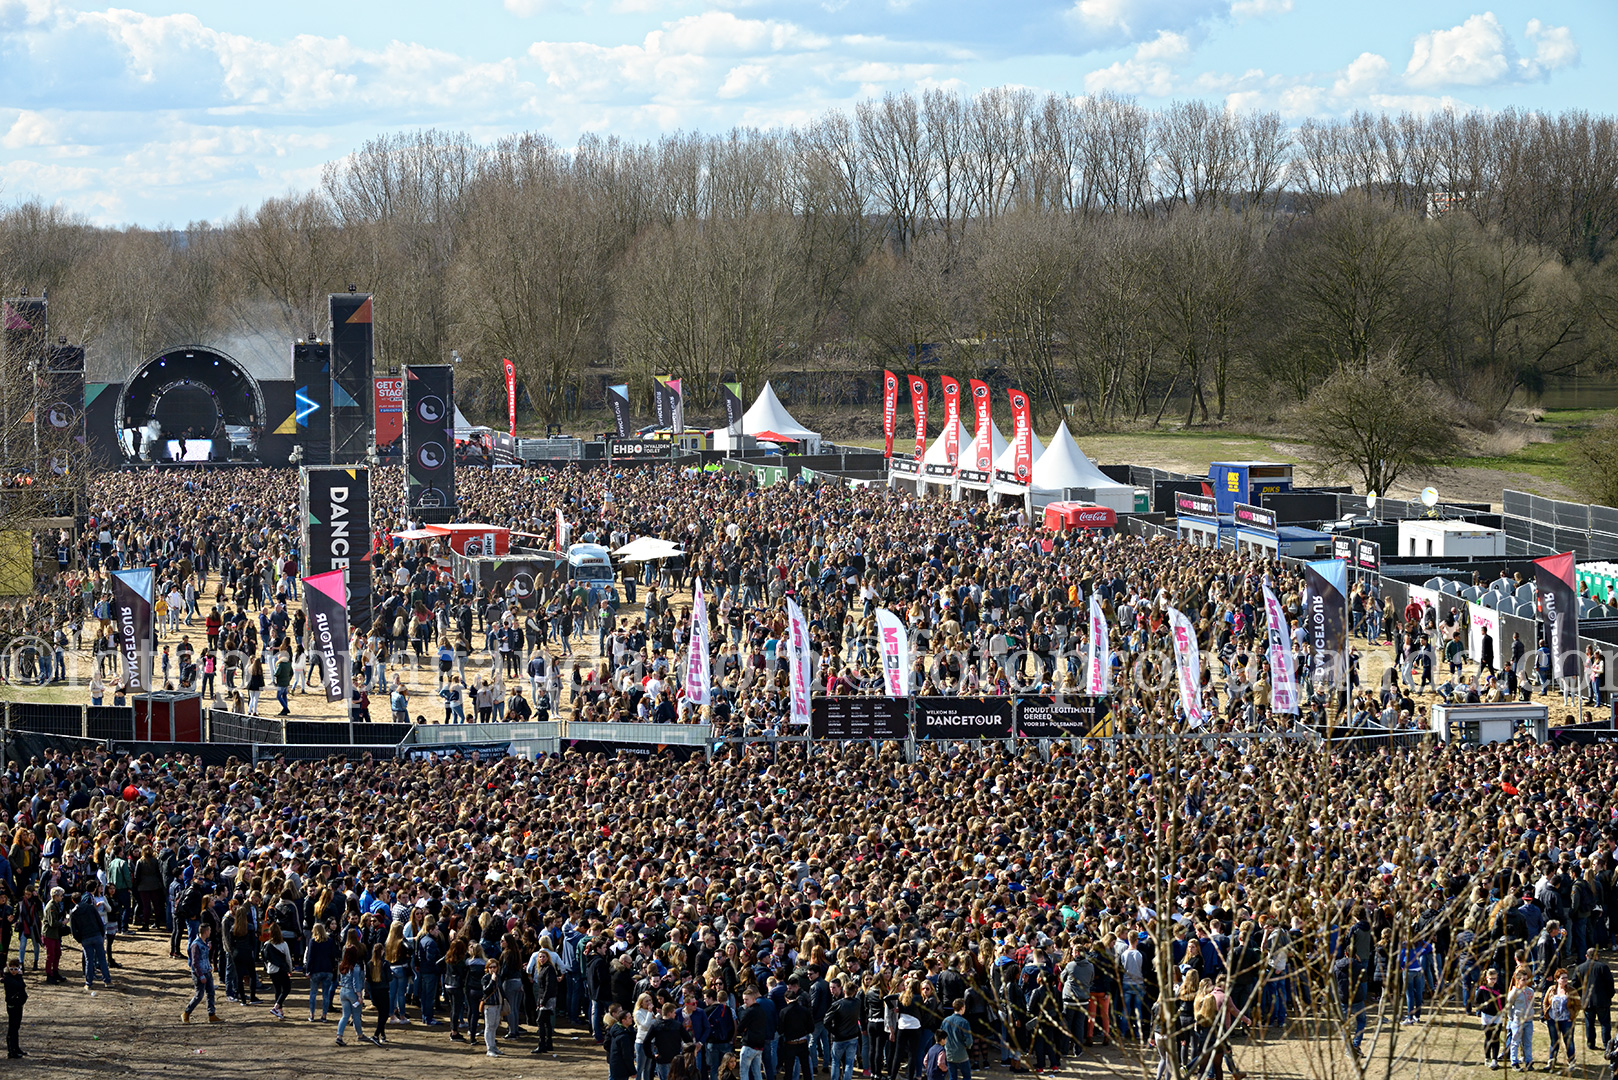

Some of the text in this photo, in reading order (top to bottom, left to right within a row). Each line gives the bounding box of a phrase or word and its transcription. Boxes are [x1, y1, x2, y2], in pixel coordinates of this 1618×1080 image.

[376, 381, 393, 389] GET
[379, 389, 403, 397] STAG
[613, 444, 642, 454] EHBO
[1228, 472, 1239, 482] DIKS
[926, 714, 1002, 725] DANCETOUR
